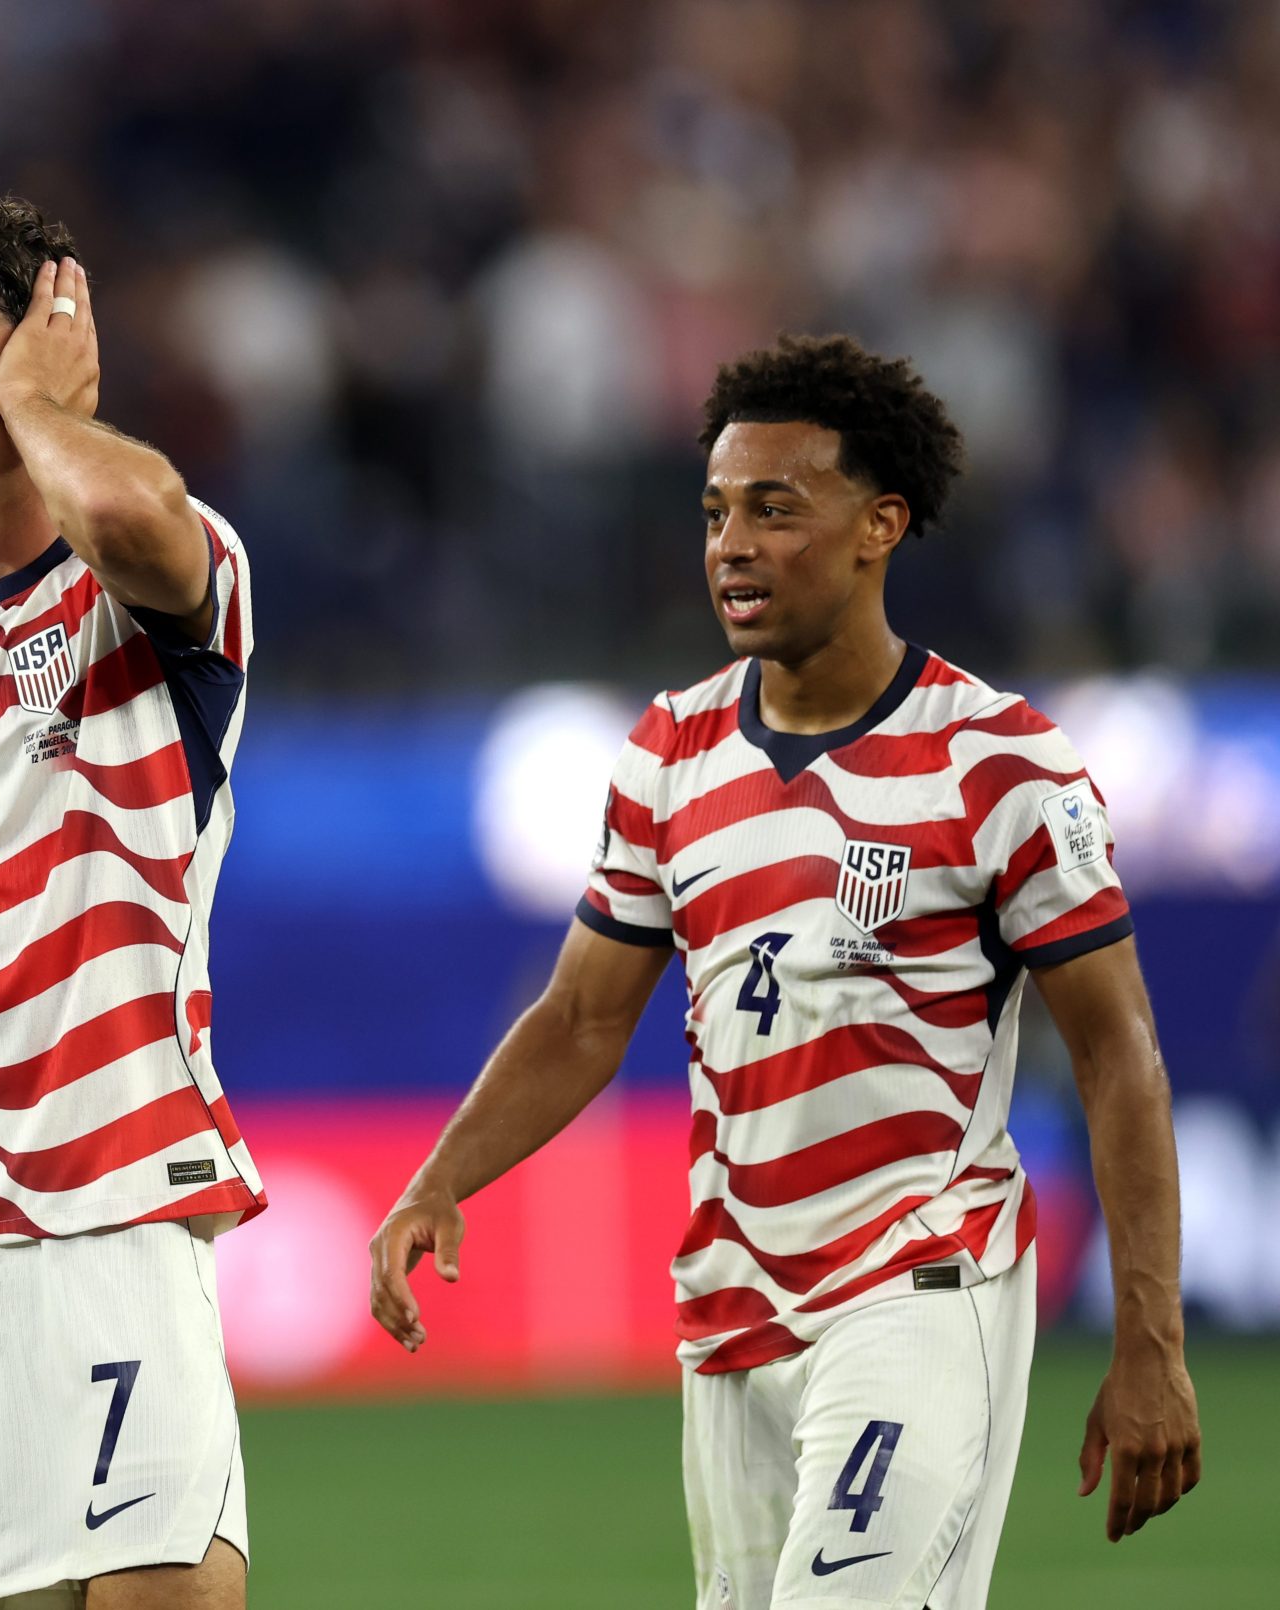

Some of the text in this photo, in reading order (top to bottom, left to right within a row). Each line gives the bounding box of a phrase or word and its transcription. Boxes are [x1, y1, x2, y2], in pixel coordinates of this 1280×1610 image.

[13, 628, 63, 671] USA
[23, 733, 34, 744] USA
[48, 720, 80, 735] PARAGUA
[26, 743, 36, 754] LOS
[73, 731, 79, 740] C
[31, 754, 39, 764] 12
[41, 748, 59, 761] JUNE
[1069, 832, 1095, 854] PEACE
[847, 845, 905, 881] USA
[1078, 850, 1093, 861] FIFA
[830, 937, 897, 952] USA VS. PARAG
[832, 949, 846, 960] LOS
[848, 952, 883, 964] ANGELES,
[736, 932, 794, 1036] 4
[91, 1360, 141, 1486] 7
[827, 1420, 904, 1533] 4
